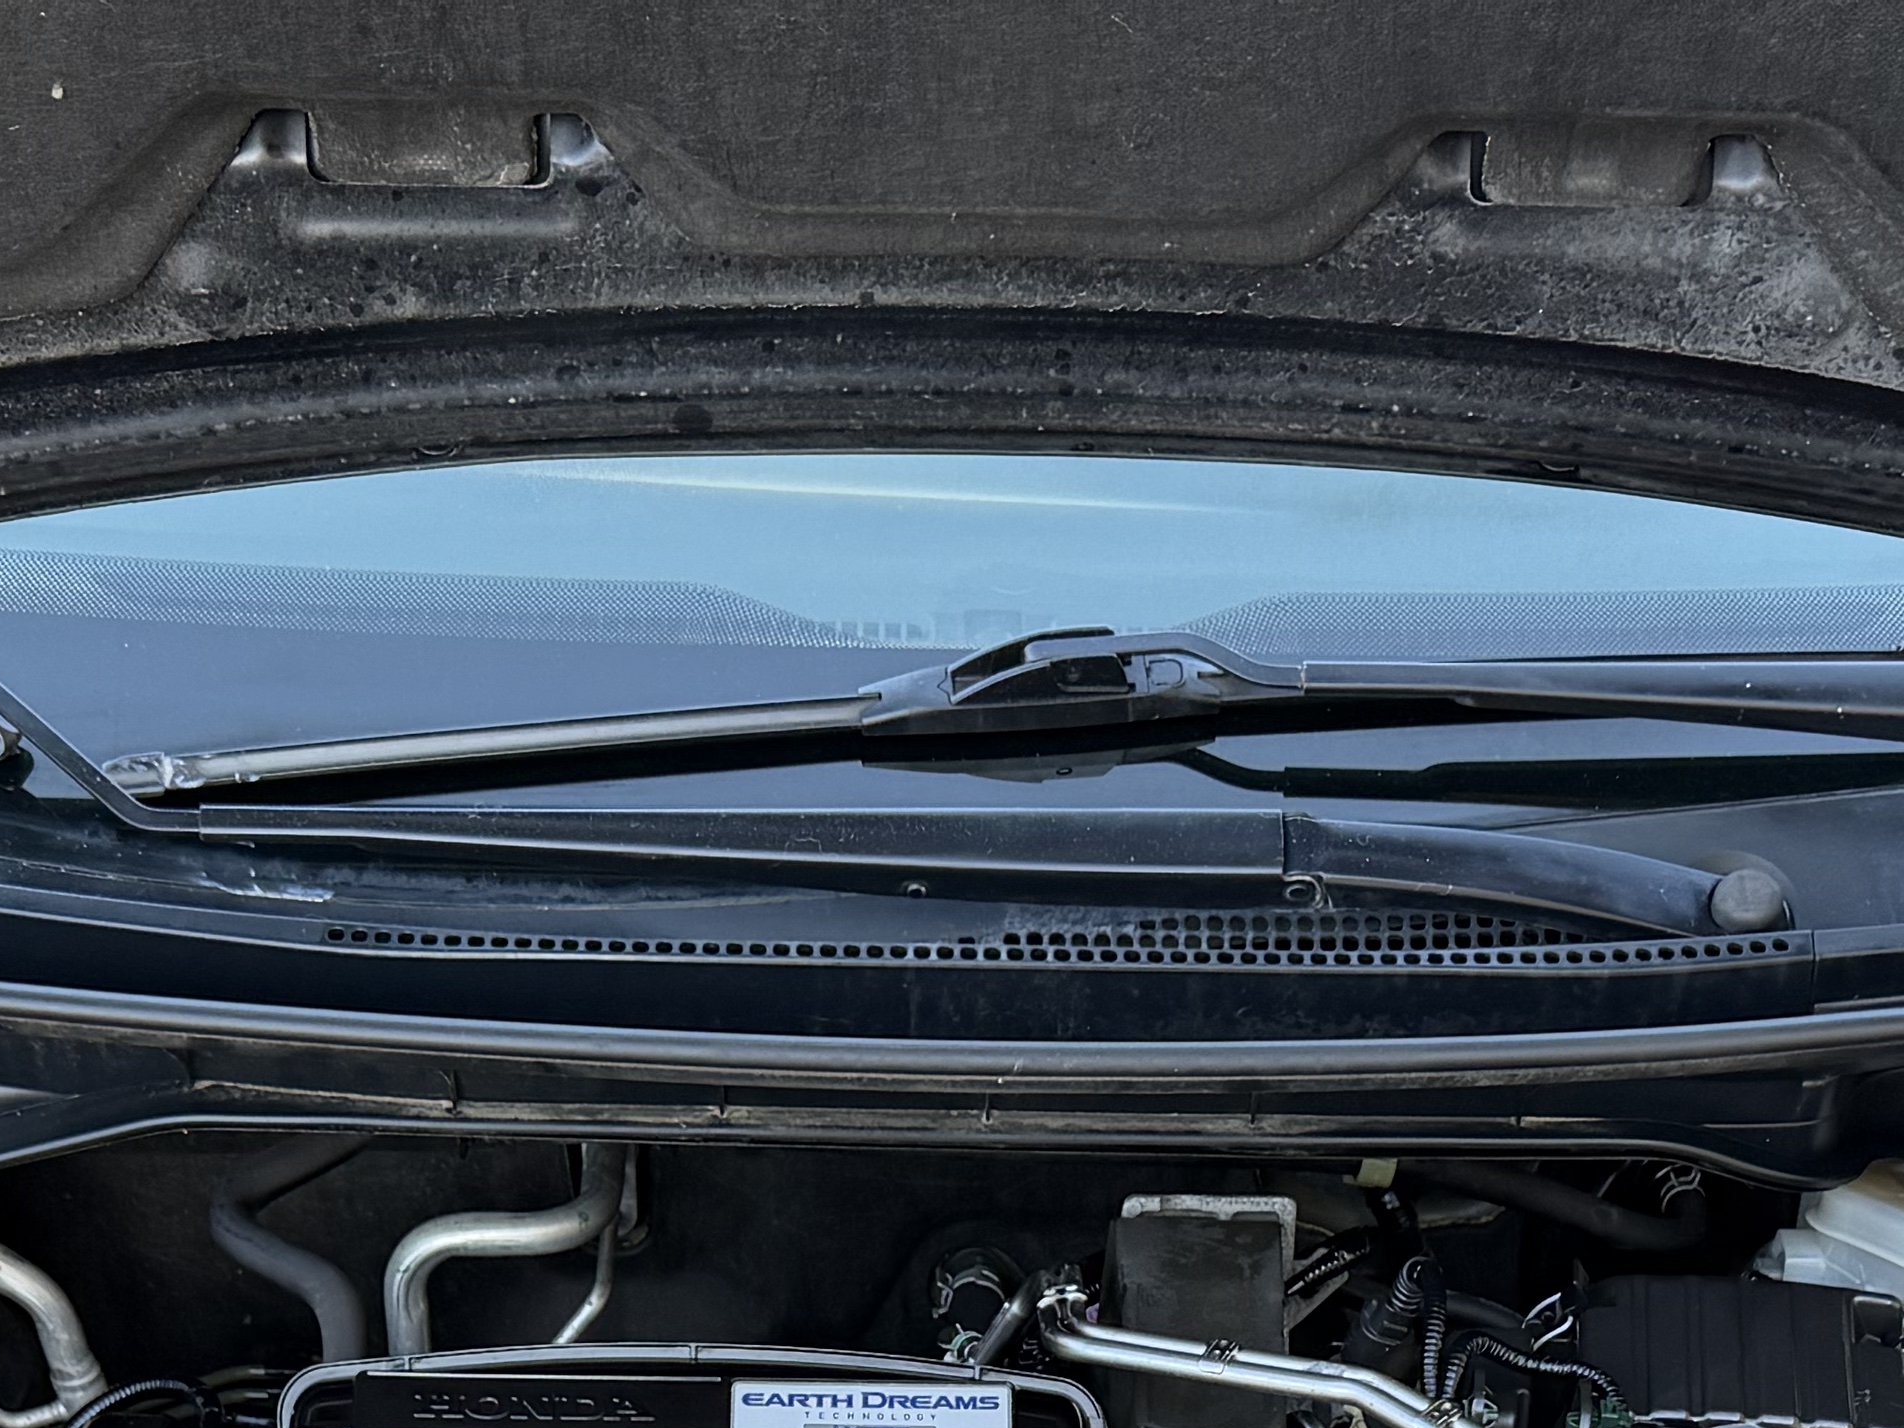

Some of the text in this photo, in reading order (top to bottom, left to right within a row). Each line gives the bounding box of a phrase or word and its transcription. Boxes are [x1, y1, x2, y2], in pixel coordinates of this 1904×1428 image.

[413, 1395, 656, 1422] HONDA
[741, 1391, 1000, 1411] EARTH DREAMS
[804, 1411, 937, 1421] TECHNOLOGY
